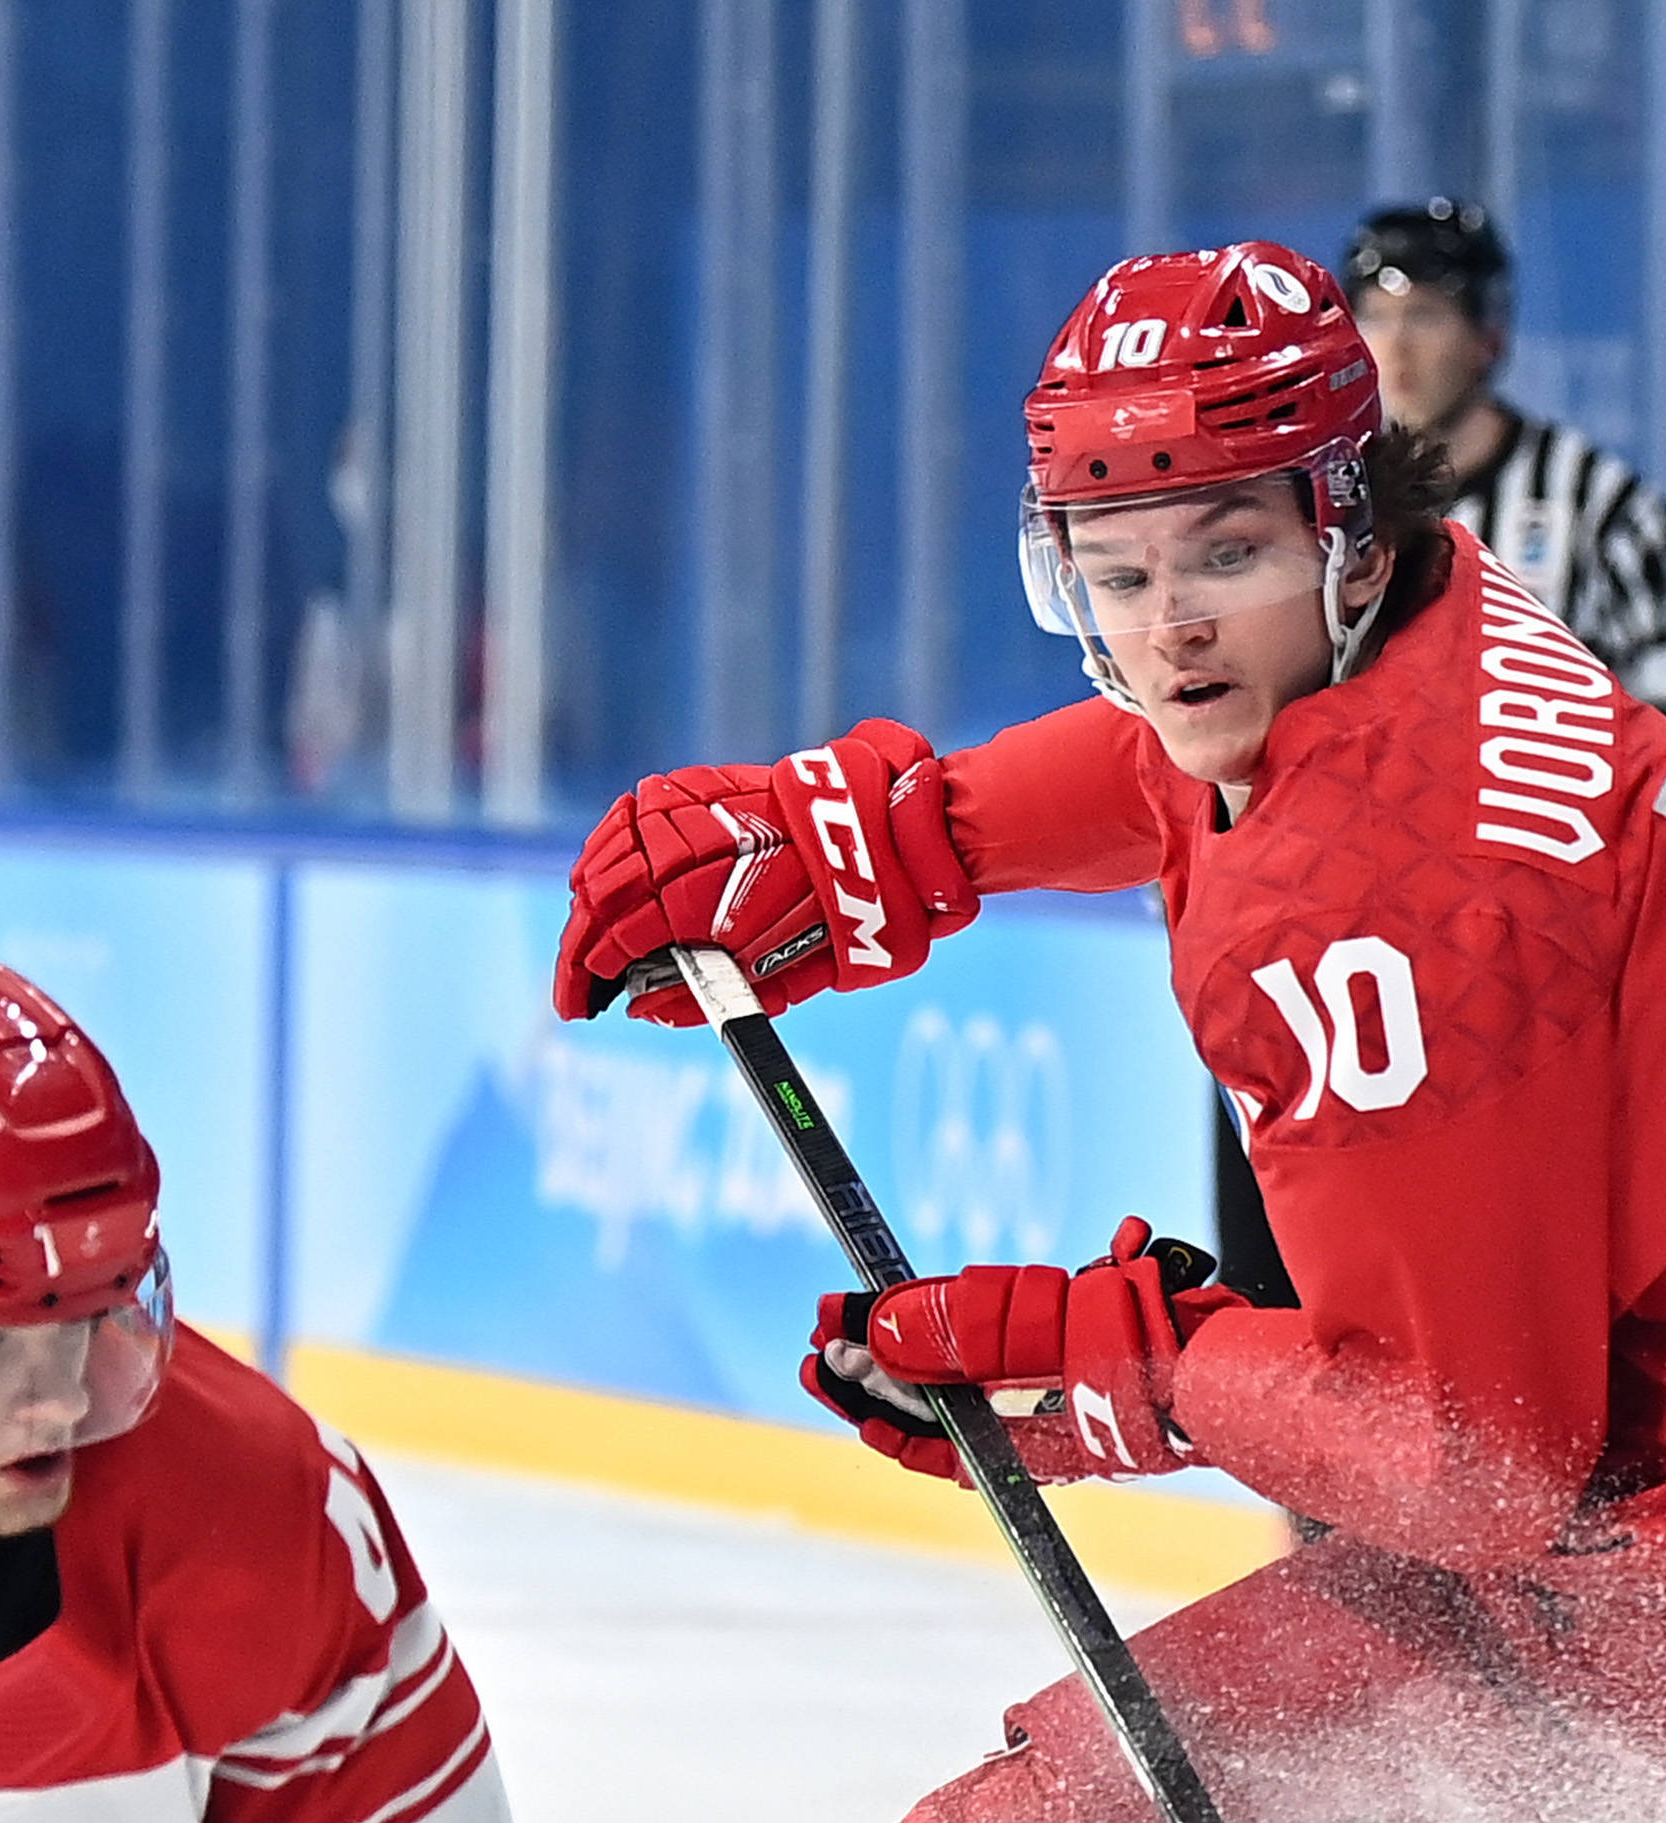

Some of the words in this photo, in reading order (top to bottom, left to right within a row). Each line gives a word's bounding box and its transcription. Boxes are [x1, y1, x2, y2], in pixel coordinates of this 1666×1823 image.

[1097, 318, 1168, 372] 10
[788, 745, 893, 969] CCM
[1251, 935, 1429, 1121] 10
